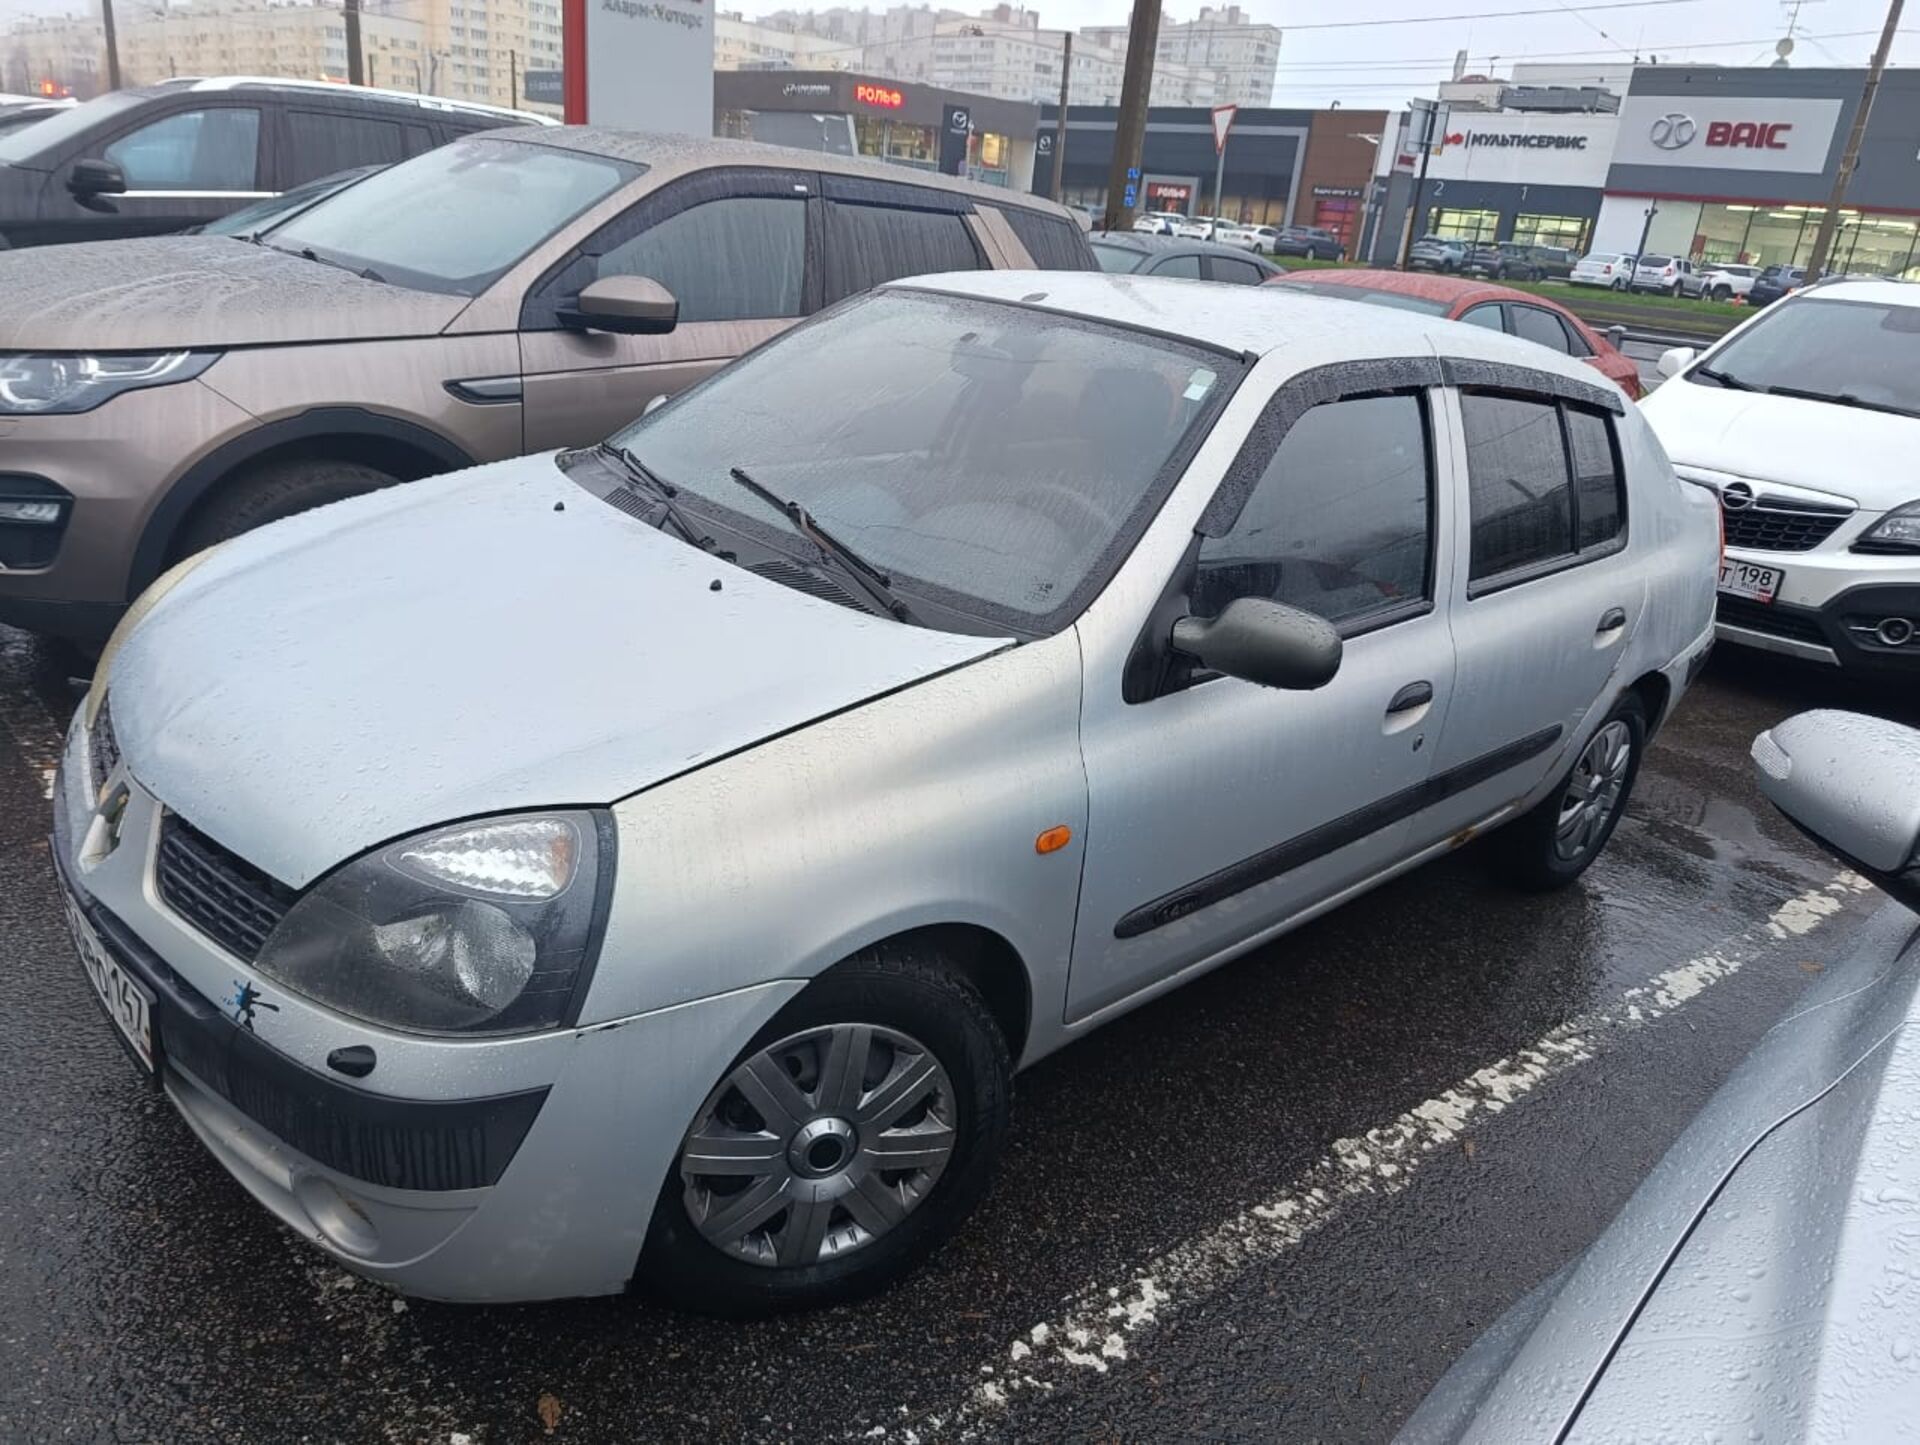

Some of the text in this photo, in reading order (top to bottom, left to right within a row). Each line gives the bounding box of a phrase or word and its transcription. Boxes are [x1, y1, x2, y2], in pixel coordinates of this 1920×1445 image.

[857, 86, 901, 105] РОЛЬФ
[1471, 133, 1588, 150] МУЛЬТИСЕРВИС
[1705, 122, 1792, 149] BAIC
[1434, 181, 1445, 196] 2
[1739, 566, 1772, 586] 198
